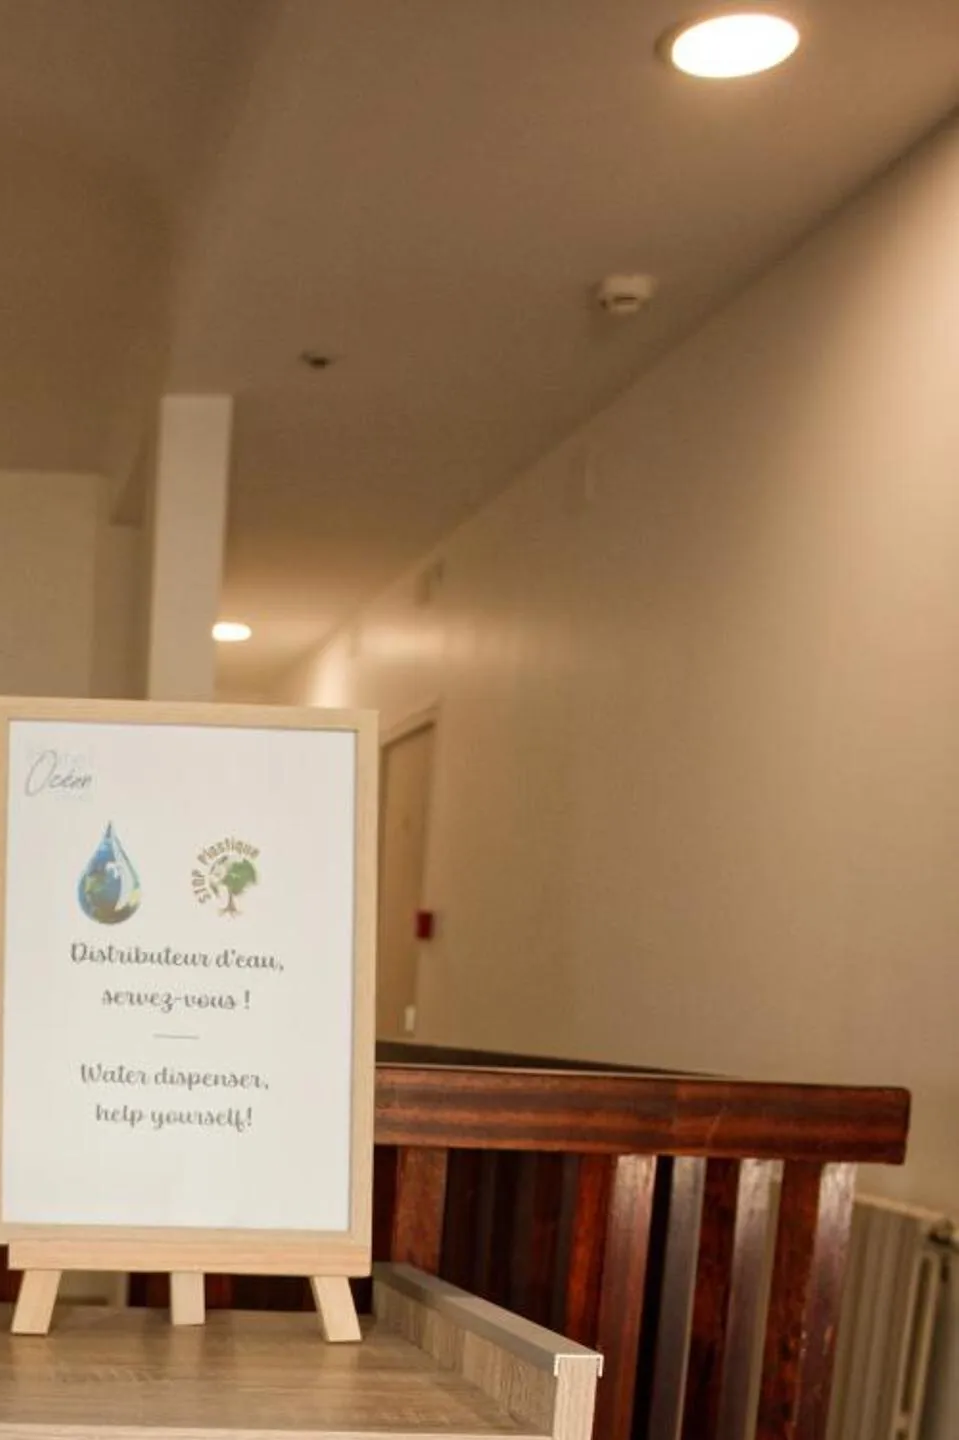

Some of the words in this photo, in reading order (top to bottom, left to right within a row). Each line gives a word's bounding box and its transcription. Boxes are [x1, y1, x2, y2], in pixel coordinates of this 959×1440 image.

[70, 942, 209, 967] Distributeur
[215, 949, 284, 972] d'eau,
[101, 988, 237, 1014] servez-vous
[80, 1063, 147, 1085] Water
[154, 1066, 269, 1091] dispenser,
[95, 1104, 143, 1128] help
[150, 1106, 253, 1133] yourself!
